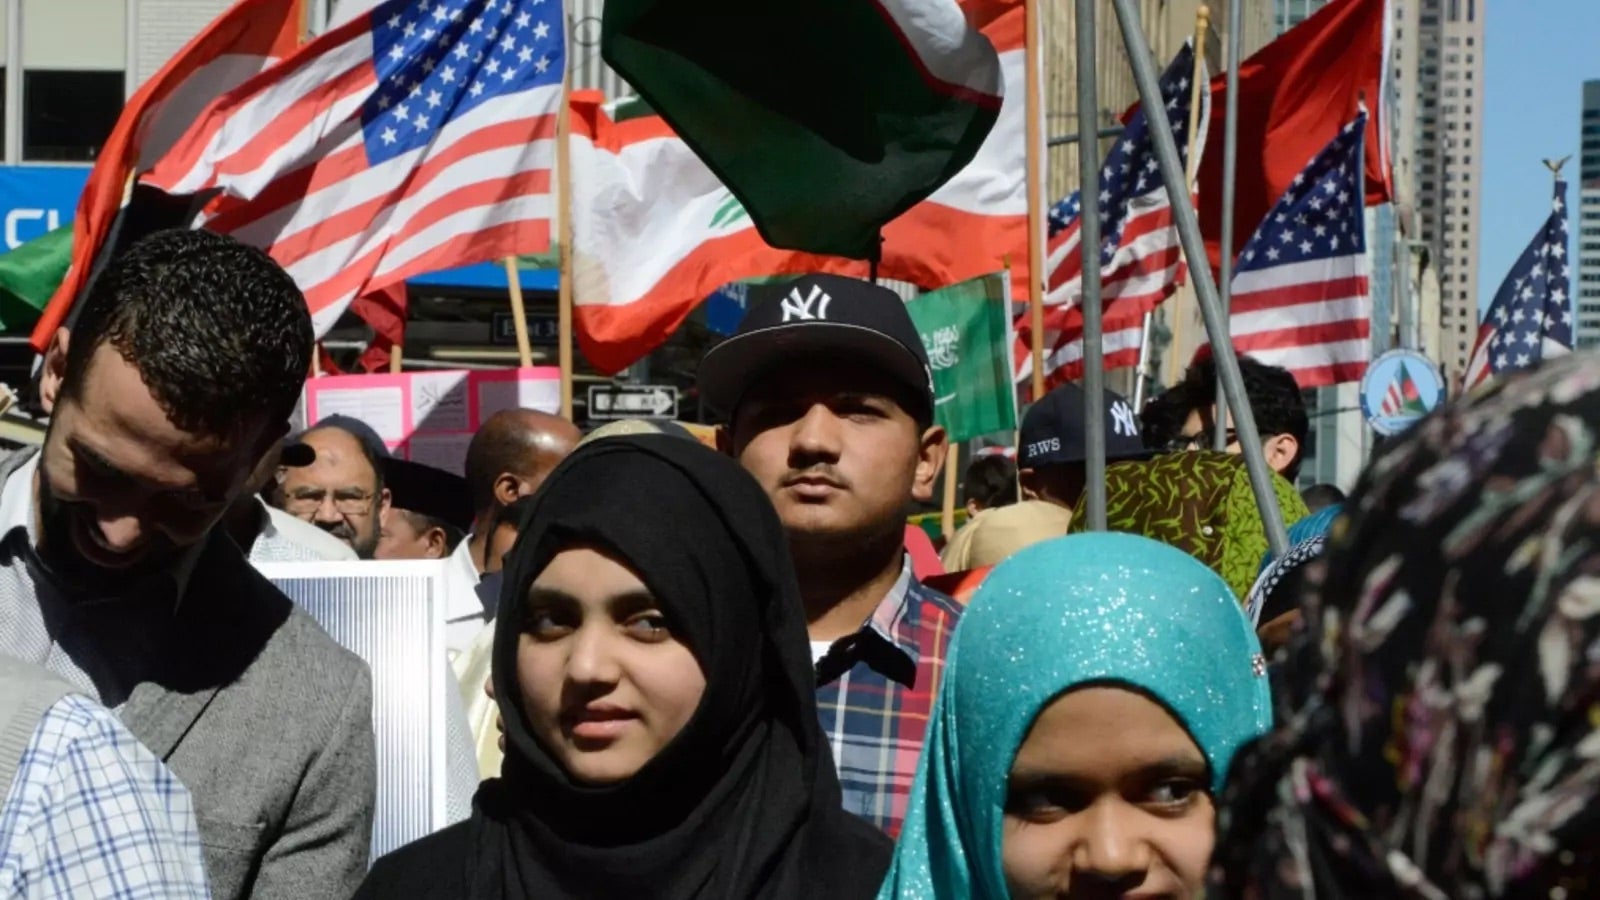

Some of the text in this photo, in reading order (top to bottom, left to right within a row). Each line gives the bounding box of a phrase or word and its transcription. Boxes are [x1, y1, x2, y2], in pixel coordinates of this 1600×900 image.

[780, 284, 832, 322] NY
[1110, 400, 1138, 437] NY
[1028, 437, 1061, 458] RWS
